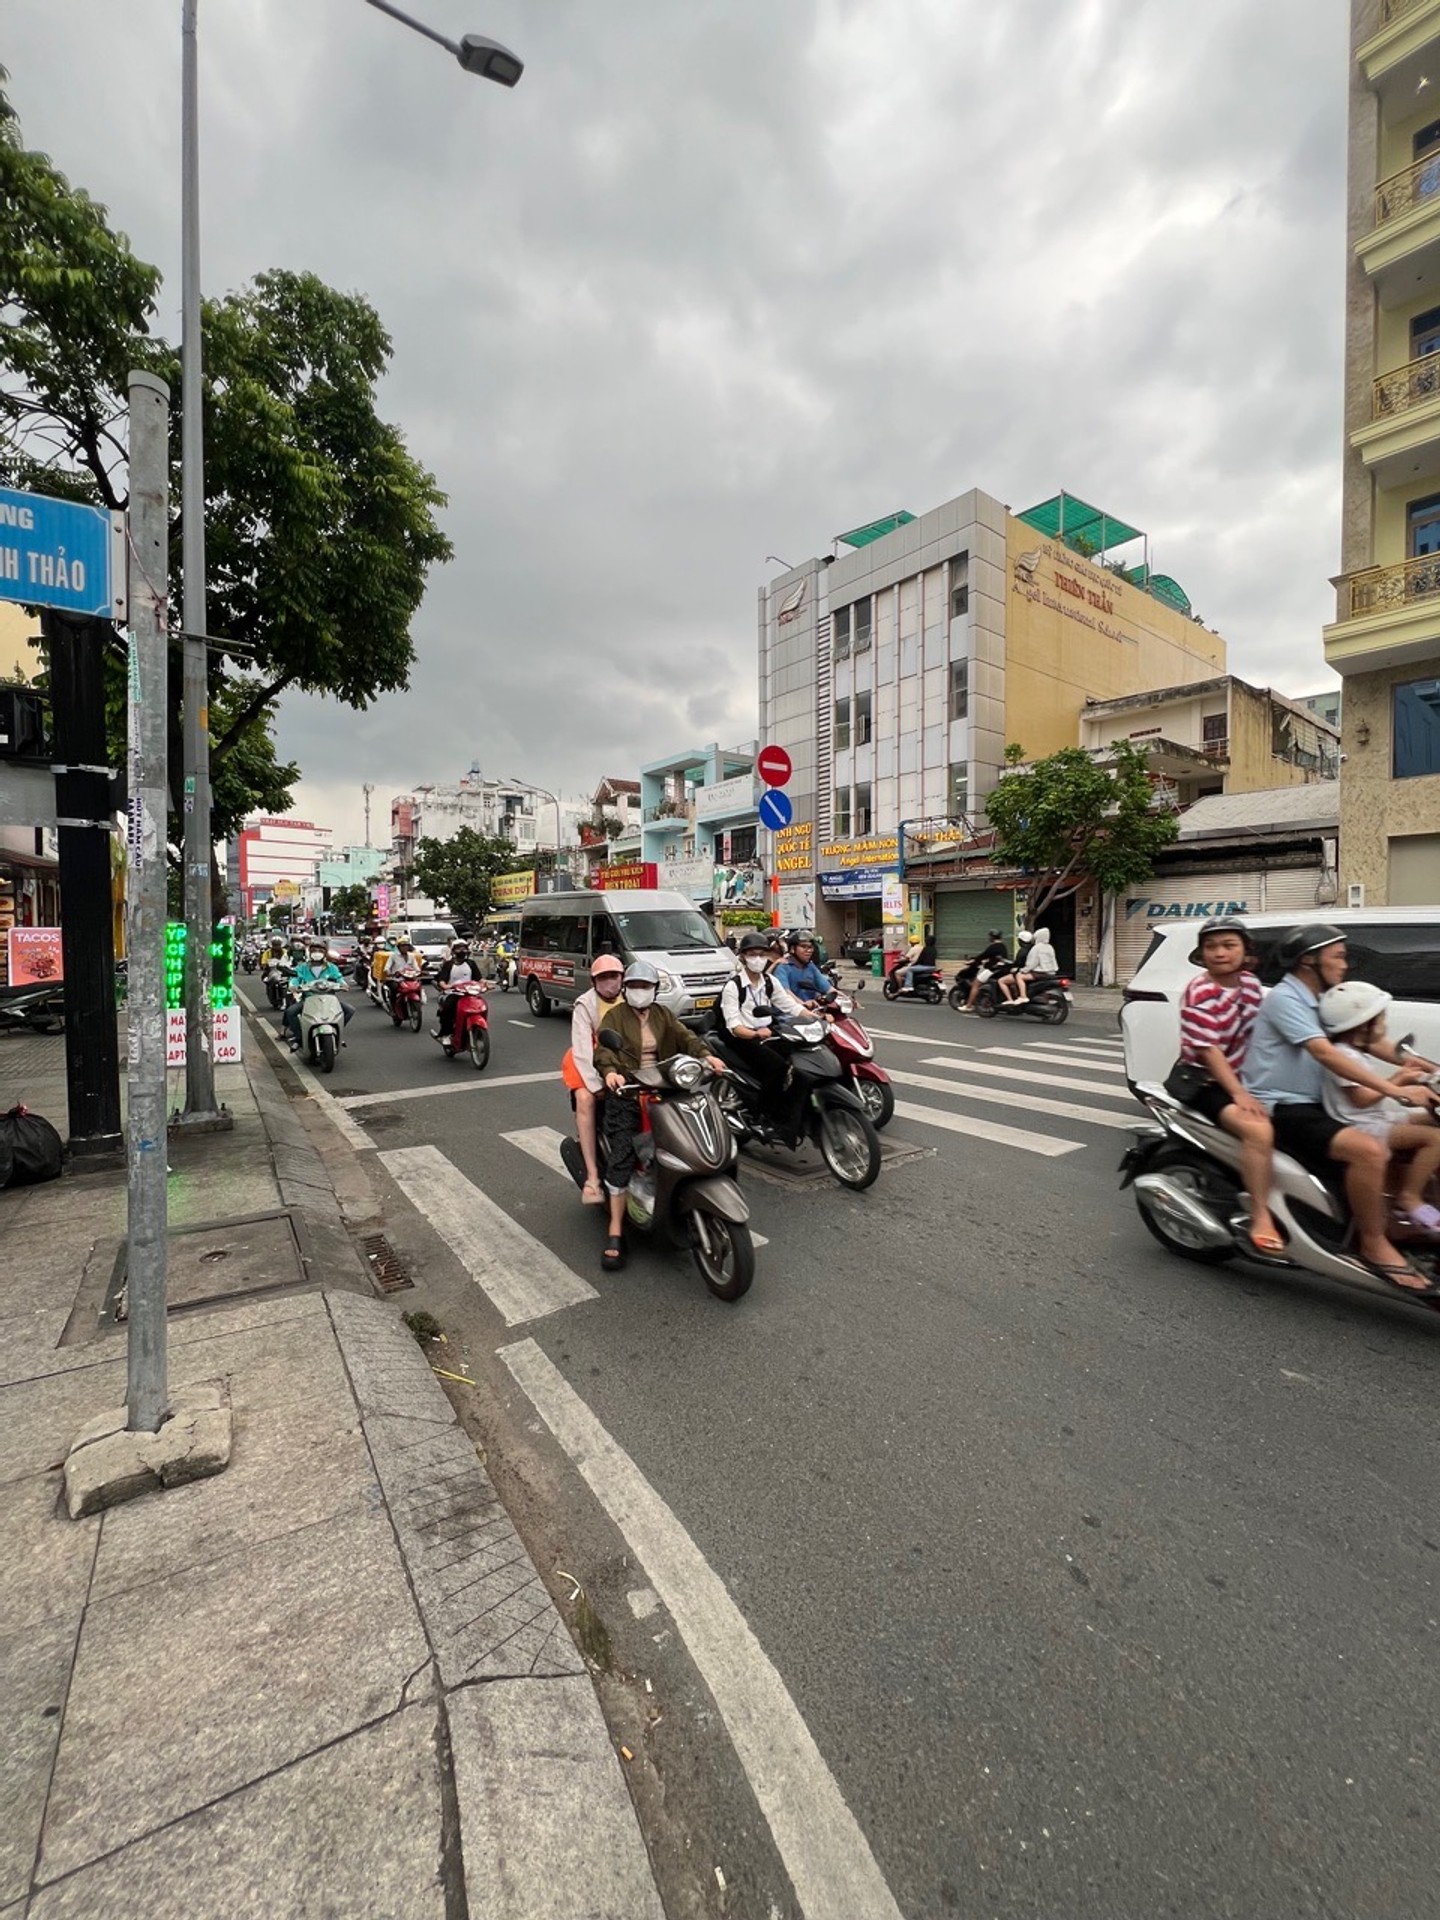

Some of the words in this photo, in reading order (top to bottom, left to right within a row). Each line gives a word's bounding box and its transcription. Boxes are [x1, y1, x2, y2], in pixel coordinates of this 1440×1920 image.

[27, 546, 85, 592] THẢO
[883, 901, 903, 909] IELTS
[1147, 901, 1246, 917] DAIKIN
[15, 932, 60, 943] TACOS
[217, 1046, 236, 1057] CAO
